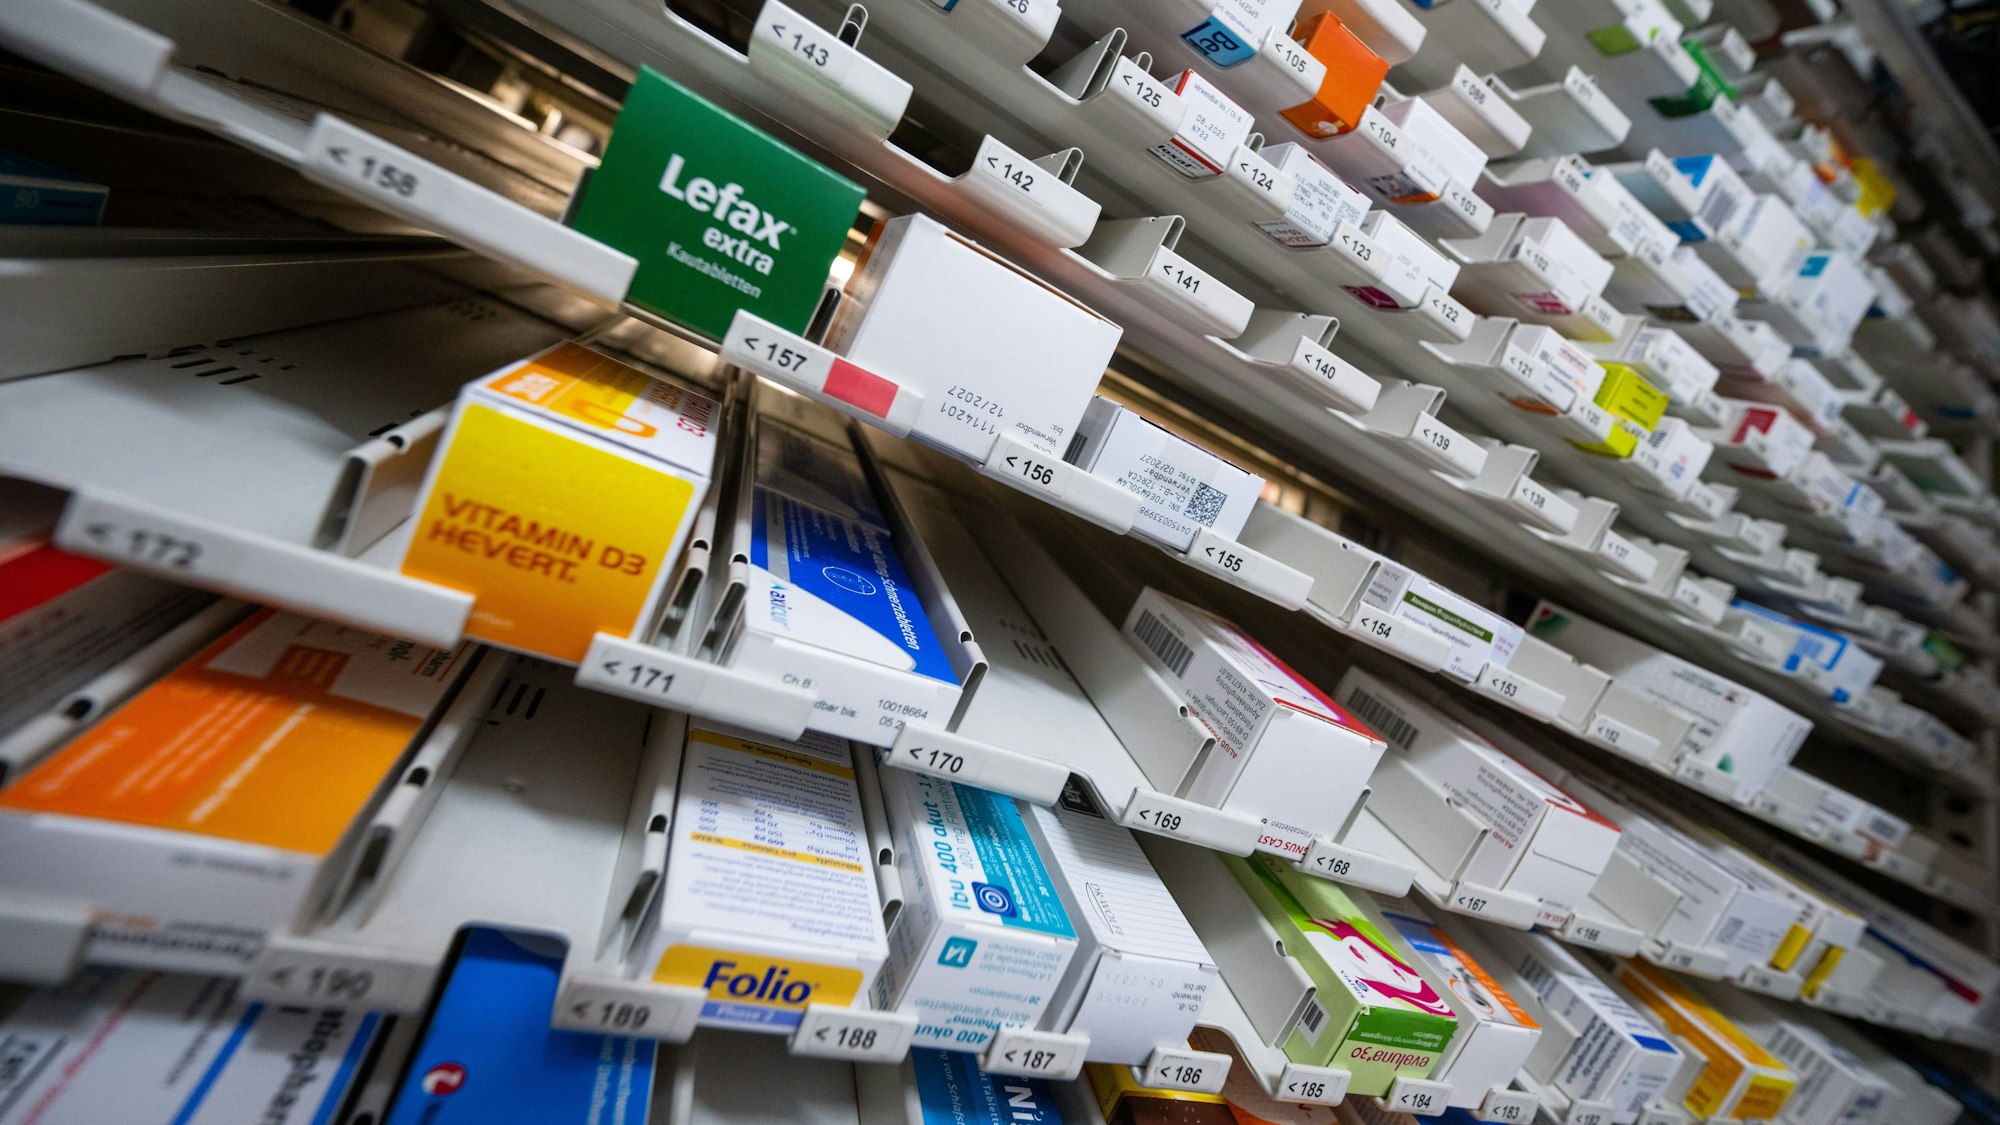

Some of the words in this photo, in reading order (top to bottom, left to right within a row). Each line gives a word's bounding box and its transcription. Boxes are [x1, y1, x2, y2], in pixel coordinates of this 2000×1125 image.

[792, 33, 829, 67] 143
[1285, 50, 1307, 73] 105
[1136, 82, 1161, 108] 125
[1193, 83, 1220, 105] verwendbar
[1195, 114, 1227, 140] 08.2025
[1378, 126, 1396, 149] 104
[360, 155, 419, 198] 158
[1003, 162, 1035, 193] 142
[1251, 168, 1273, 192] 124
[658, 154, 791, 251] Lefax
[1459, 196, 1477, 217] 103
[703, 226, 775, 276] extra
[1351, 240, 1372, 262] 123
[667, 241, 763, 299] Kautabletten
[1177, 270, 1200, 294] 141
[1441, 302, 1460, 323] 122
[765, 342, 807, 373] 157
[1314, 357, 1336, 380] 140
[1517, 357, 1533, 378] 121
[947, 383, 1006, 418] 12/2027
[939, 401, 997, 436] 1114201
[1015, 421, 1058, 447] Verwendbar
[1431, 430, 1450, 451] 139
[1023, 460, 1053, 485] 156
[1139, 452, 1175, 475] 02/2027
[1143, 466, 1191, 495] Verwendbar
[1530, 490, 1545, 510] 138
[443, 492, 595, 561] VITAMIN
[598, 542, 648, 577] D3
[1218, 547, 1243, 572] 155
[1373, 618, 1392, 639] 154
[631, 664, 675, 692] 171
[1502, 678, 1517, 697] 153
[876, 698, 928, 721] 10018664
[1213, 675, 1261, 720] Apothekenpflichtig
[1222, 698, 1256, 730] Filmtablette
[928, 748, 963, 773] 170
[1219, 739, 1238, 760] ALIUD
[921, 798, 948, 841] akut
[1153, 810, 1181, 832] 169
[1500, 804, 1529, 827] Tablette
[1270, 820, 1313, 838] Filmtabletten
[933, 836, 959, 878] 400
[1329, 857, 1350, 876] 168
[943, 876, 972, 914] Ibu
[1470, 894, 1487, 912] 167
[702, 958, 809, 1005] Folio
[601, 1001, 650, 1029] 189
[838, 1025, 877, 1050] 188
[955, 1029, 988, 1045] 400
[1021, 1049, 1056, 1072] 187
[1174, 1066, 1202, 1085] 186
[1302, 1080, 1324, 1100] 185
[1414, 1092, 1432, 1109] 184
[1505, 1103, 1521, 1119] 183
